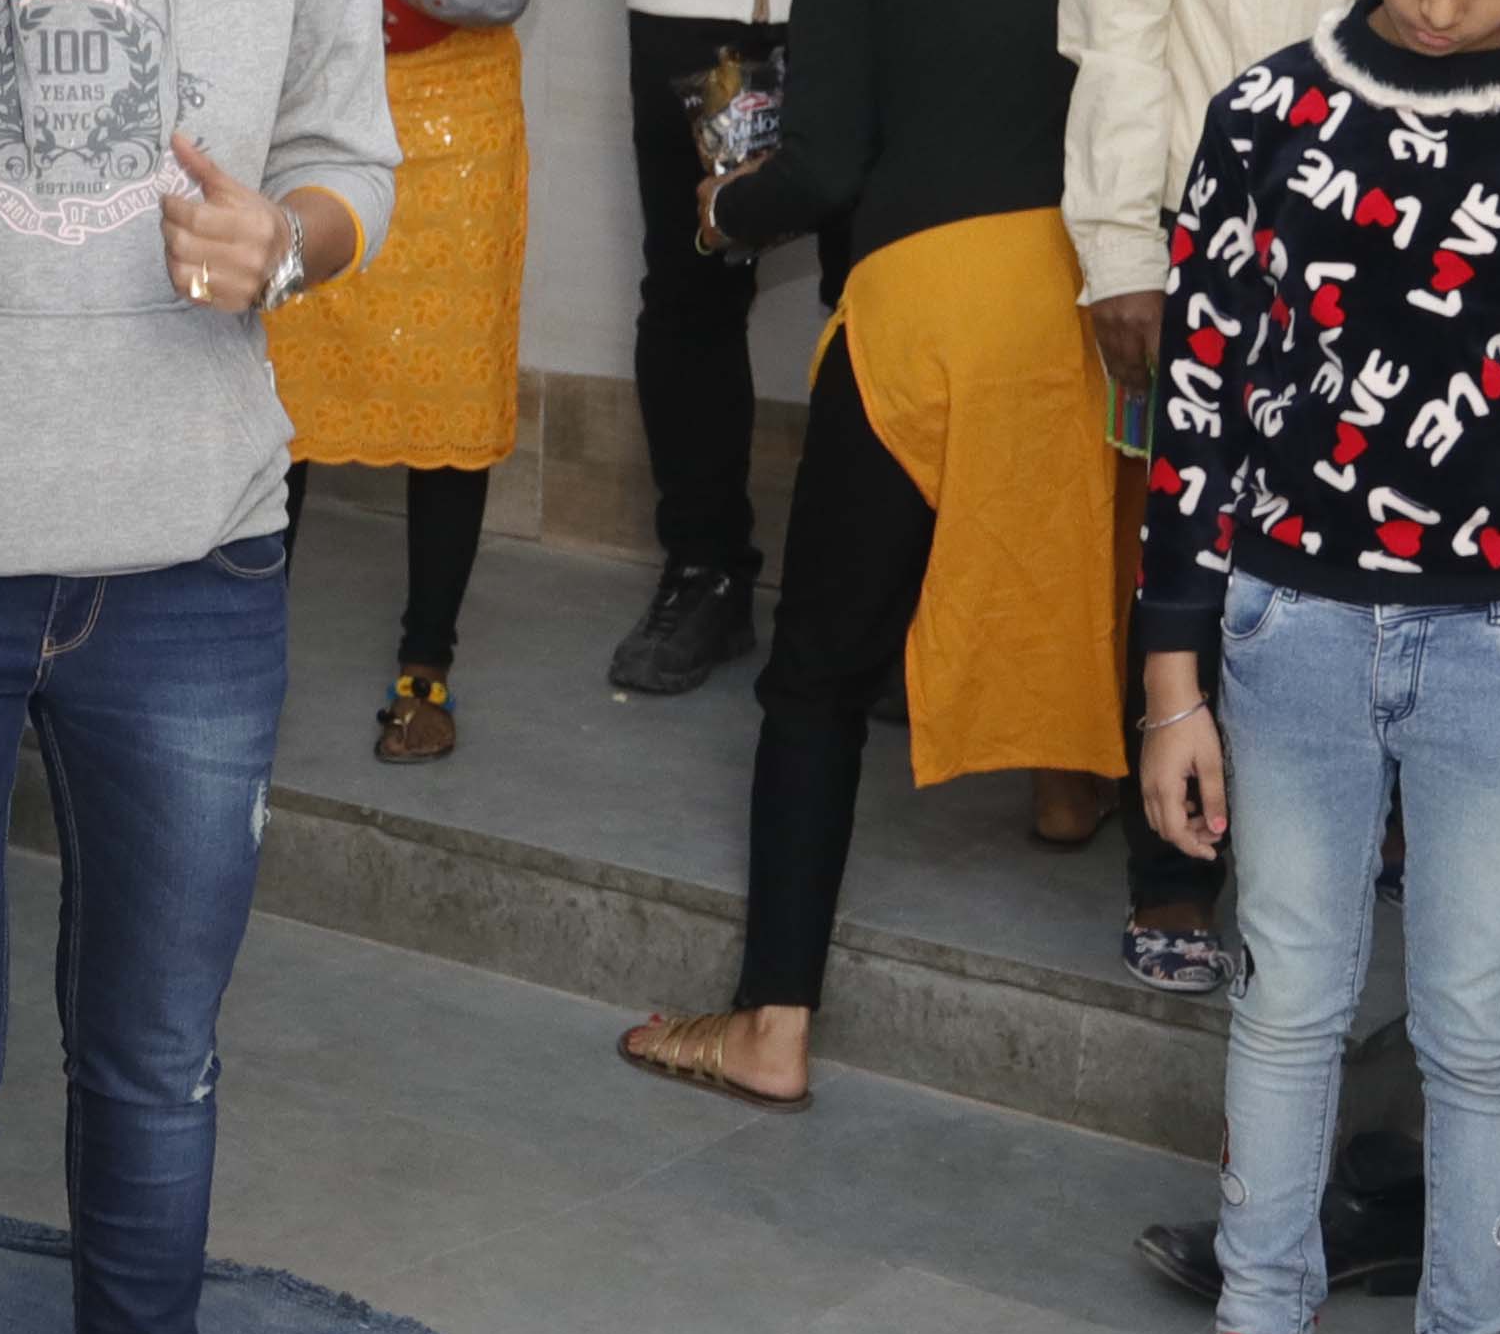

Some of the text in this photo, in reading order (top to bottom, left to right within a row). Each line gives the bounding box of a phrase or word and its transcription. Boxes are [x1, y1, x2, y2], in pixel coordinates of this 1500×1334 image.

[36, 29, 110, 75] 100
[39, 83, 106, 102] YEARS
[52, 112, 92, 132] NYC
[68, 204, 91, 226] OF
[98, 159, 183, 225] CHAMPIONS
